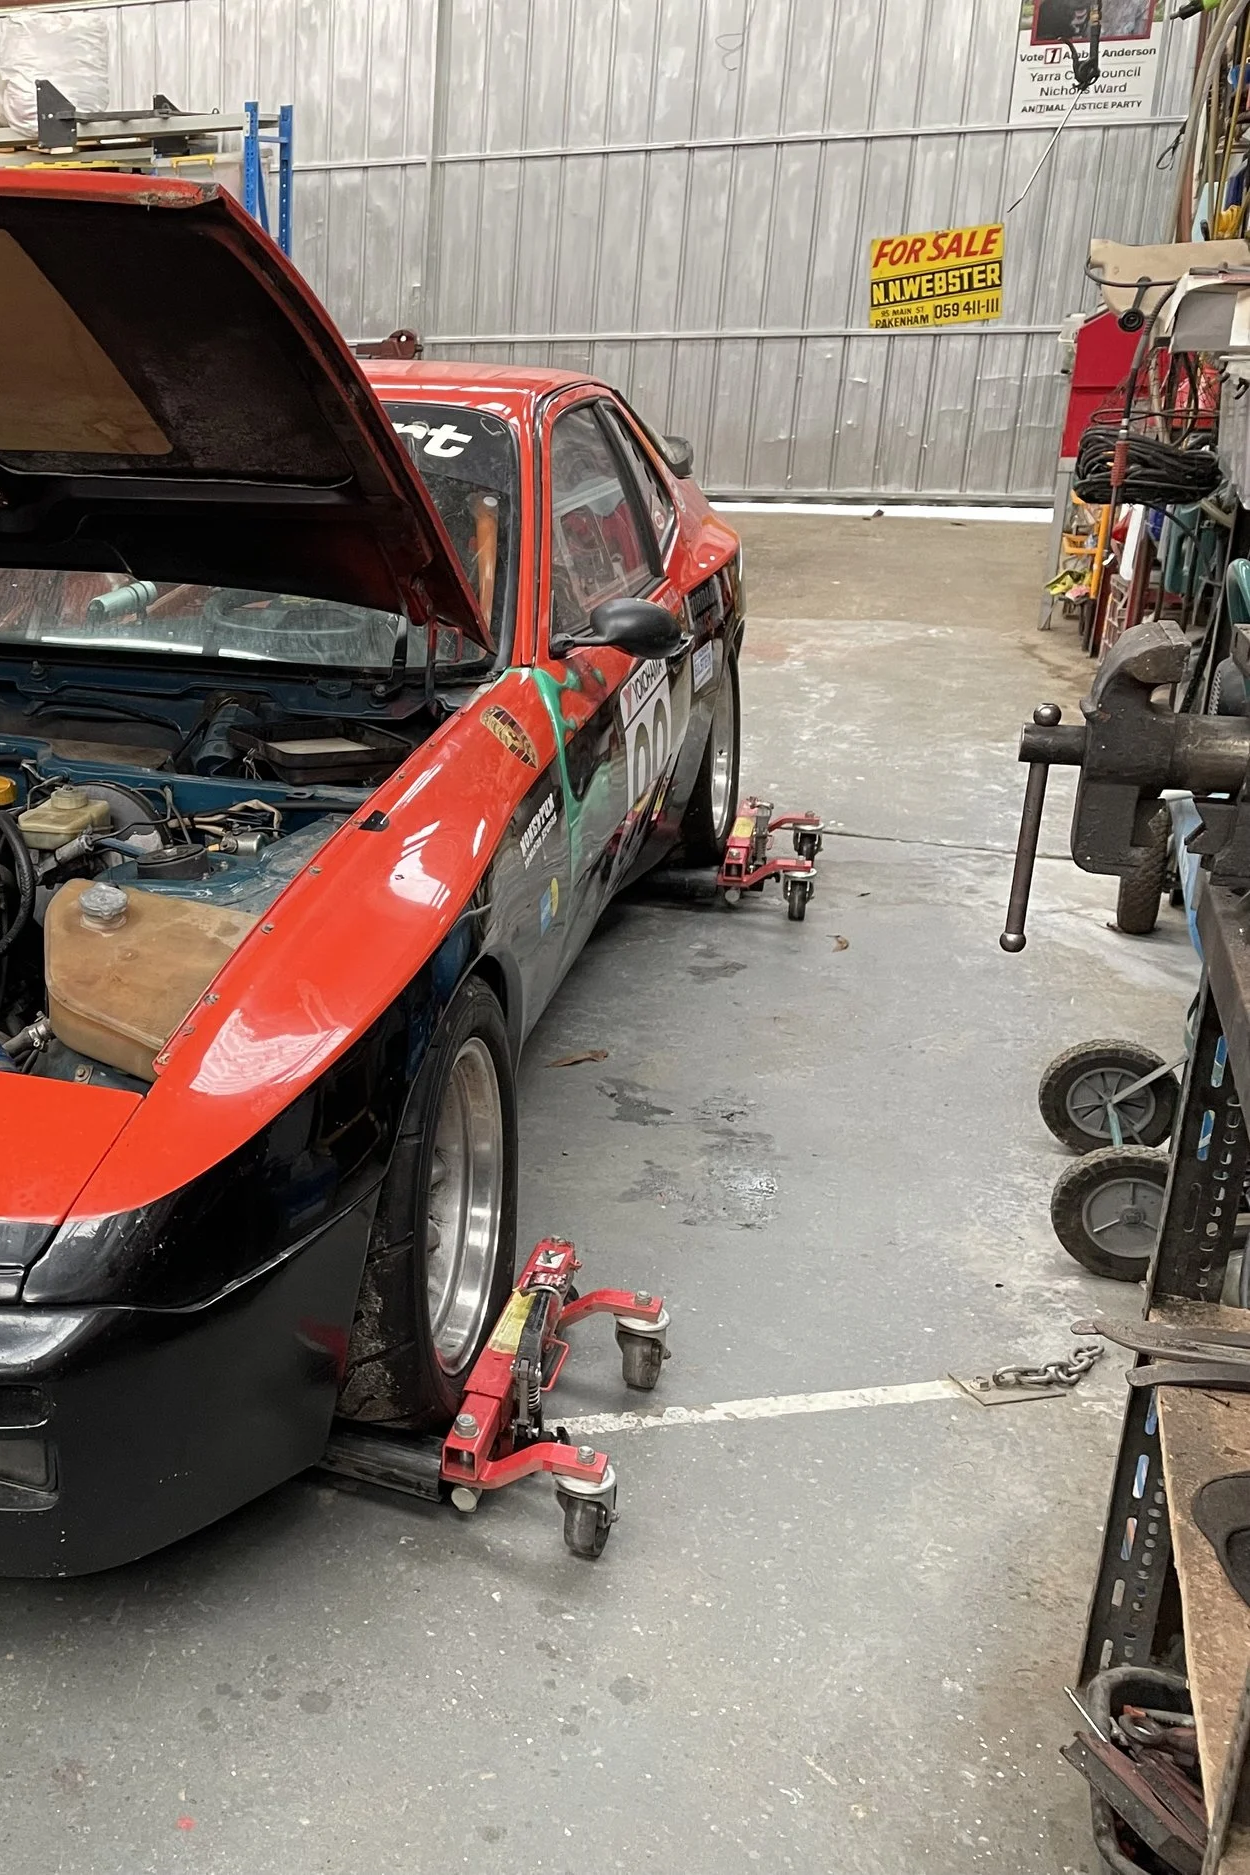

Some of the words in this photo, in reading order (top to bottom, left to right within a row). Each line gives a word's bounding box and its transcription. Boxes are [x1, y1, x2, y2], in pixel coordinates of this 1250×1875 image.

[1019, 53, 1045, 63] Vote
[1047, 48, 1059, 64] 1
[1101, 47, 1157, 58] Anderson
[1030, 72, 1061, 82] Yarra
[1100, 66, 1141, 79] ouncil
[1093, 83, 1128, 94] Ward
[1110, 100, 1143, 109] PARTY
[872, 237, 927, 268] FOR
[926, 227, 1002, 262] SALE
[891, 308, 912, 316] MAIN
[933, 302, 960, 319] 059
[962, 297, 999, 316] 411-111
[875, 314, 930, 329] PAKENHAM
[630, 659, 664, 704] YOKOHAMA
